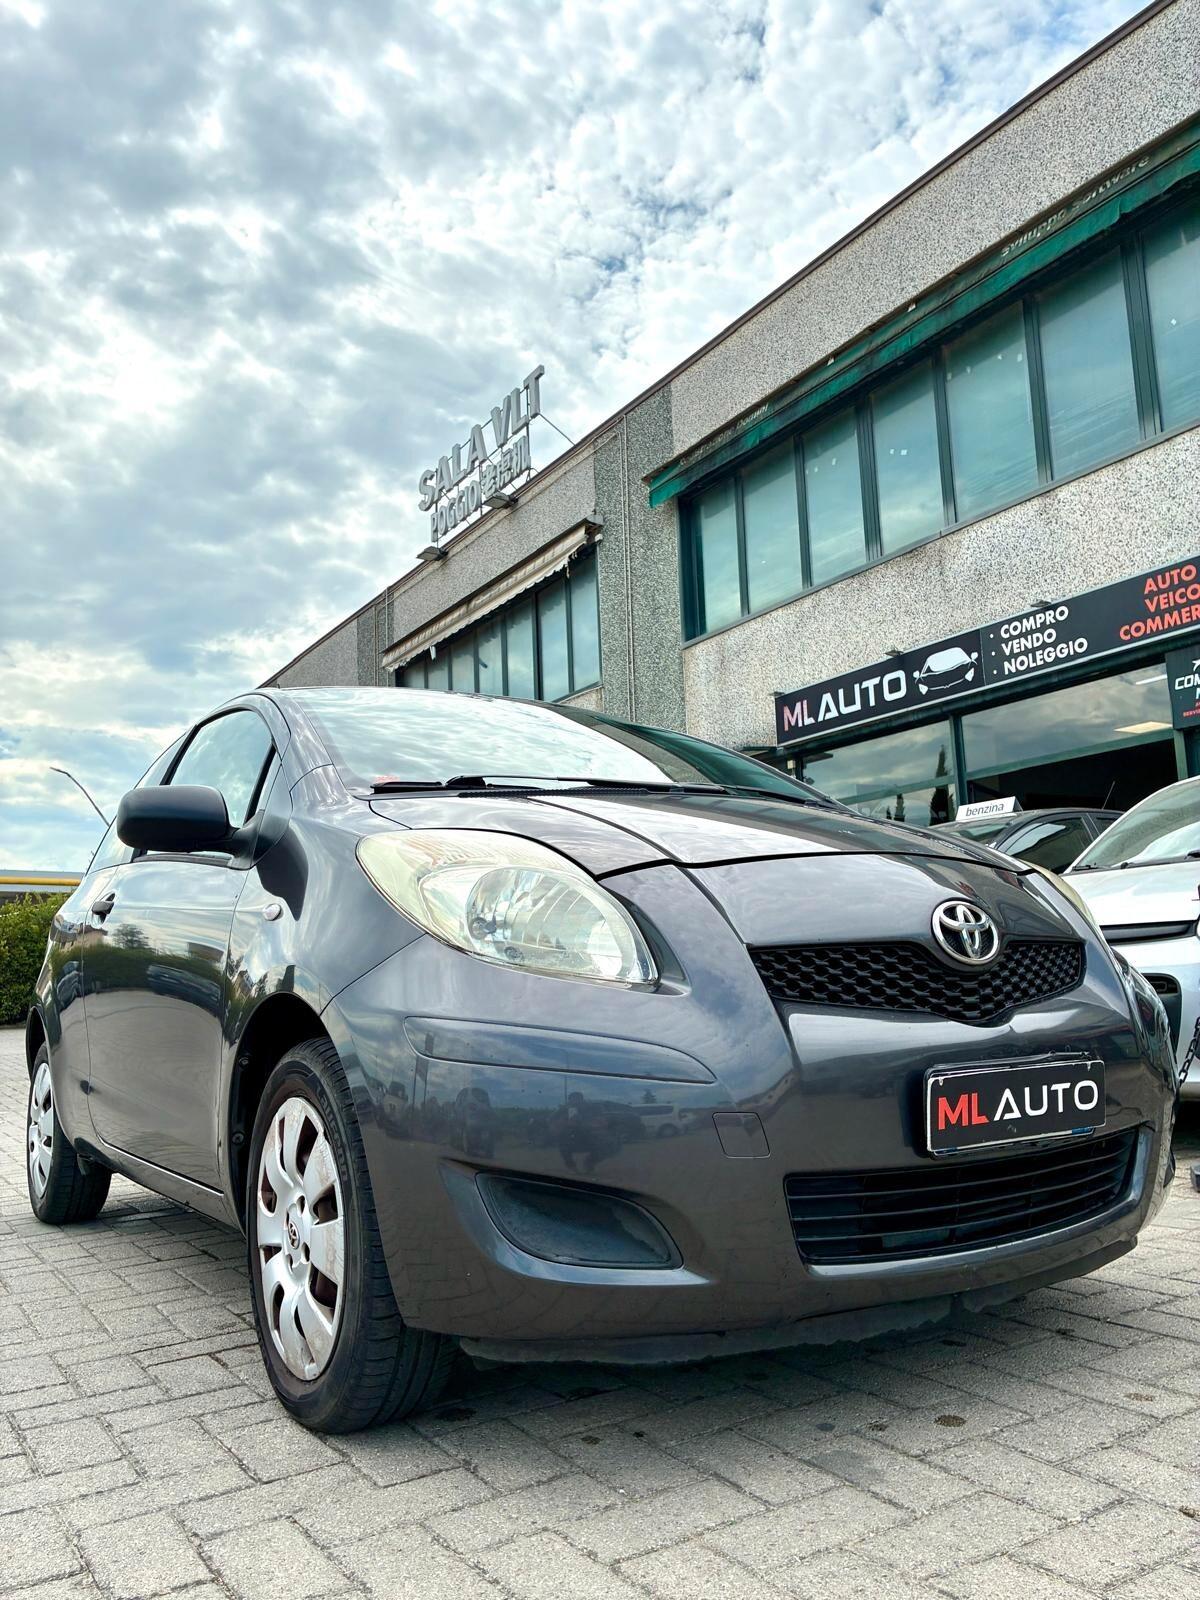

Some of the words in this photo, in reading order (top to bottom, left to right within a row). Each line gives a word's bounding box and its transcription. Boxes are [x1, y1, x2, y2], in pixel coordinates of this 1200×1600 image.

[418, 424, 487, 512] SALA
[490, 364, 545, 448] VLT
[431, 480, 482, 542] POGGIO
[1144, 564, 1197, 594] AUTO
[1144, 583, 1200, 613] VEICO
[1000, 605, 1069, 639] COMPRO
[1119, 604, 1200, 641] COMMER
[1001, 628, 1057, 656] VENDO
[1003, 637, 1088, 675] NOLEGGIO
[966, 803, 1005, 817] benzina
